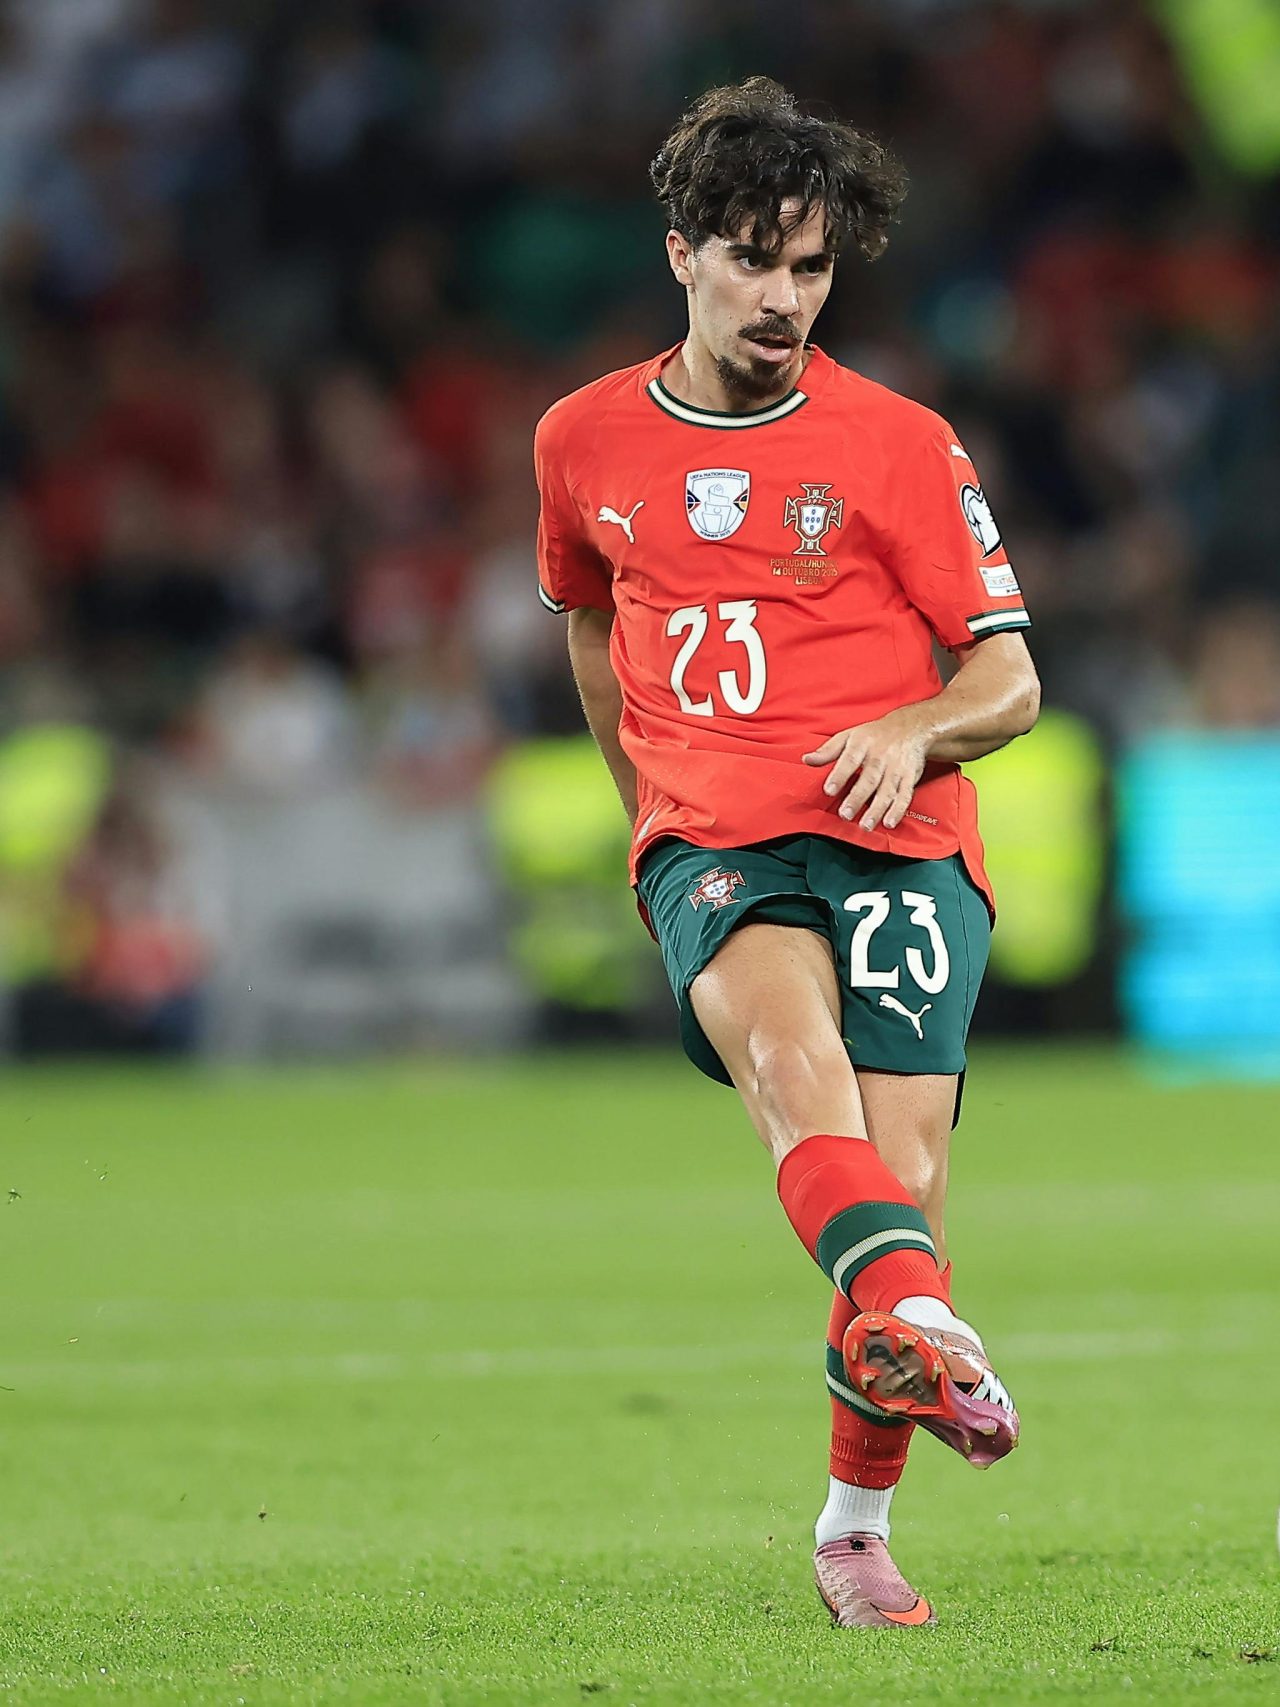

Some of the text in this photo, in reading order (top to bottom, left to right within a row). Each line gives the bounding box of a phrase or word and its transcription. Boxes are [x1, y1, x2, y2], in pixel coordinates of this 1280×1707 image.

[782, 567, 820, 577] OUTUBRO
[666, 599, 767, 717] 23
[905, 810, 938, 826] LTRAWEAVE
[843, 889, 950, 995] 23
